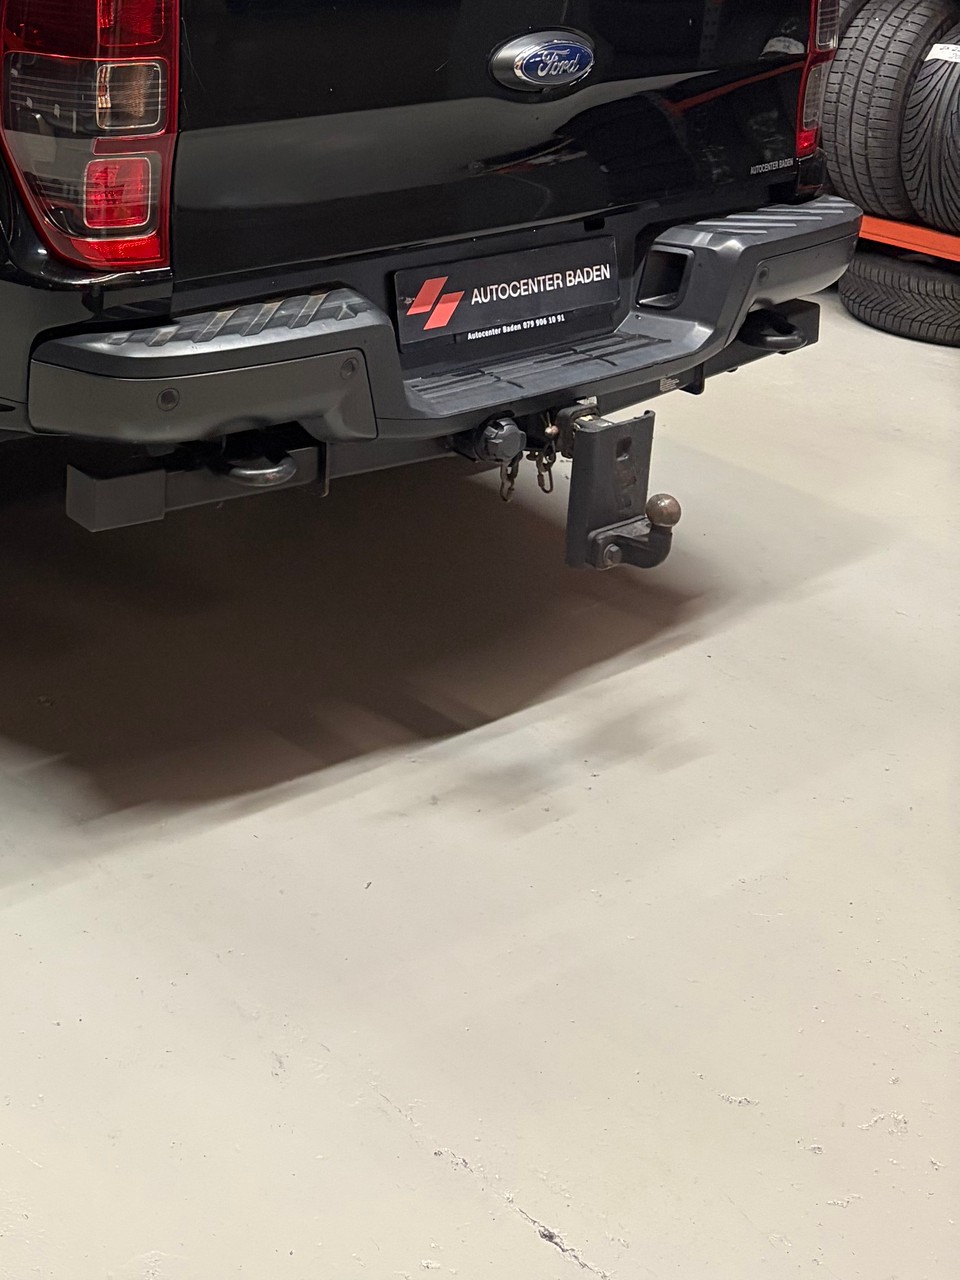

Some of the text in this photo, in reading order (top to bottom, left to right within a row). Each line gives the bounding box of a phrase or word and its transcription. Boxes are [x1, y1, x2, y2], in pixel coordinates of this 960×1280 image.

[537, 48, 580, 78] Ford
[750, 158, 793, 175] AUTOCENTER BADEN
[471, 264, 610, 305] AUTOCENTER BADEN
[467, 327, 501, 341] Autocenter
[502, 323, 521, 333] Baden
[523, 320, 534, 329] 079
[548, 315, 556, 324] 10
[557, 314, 565, 323] 91
